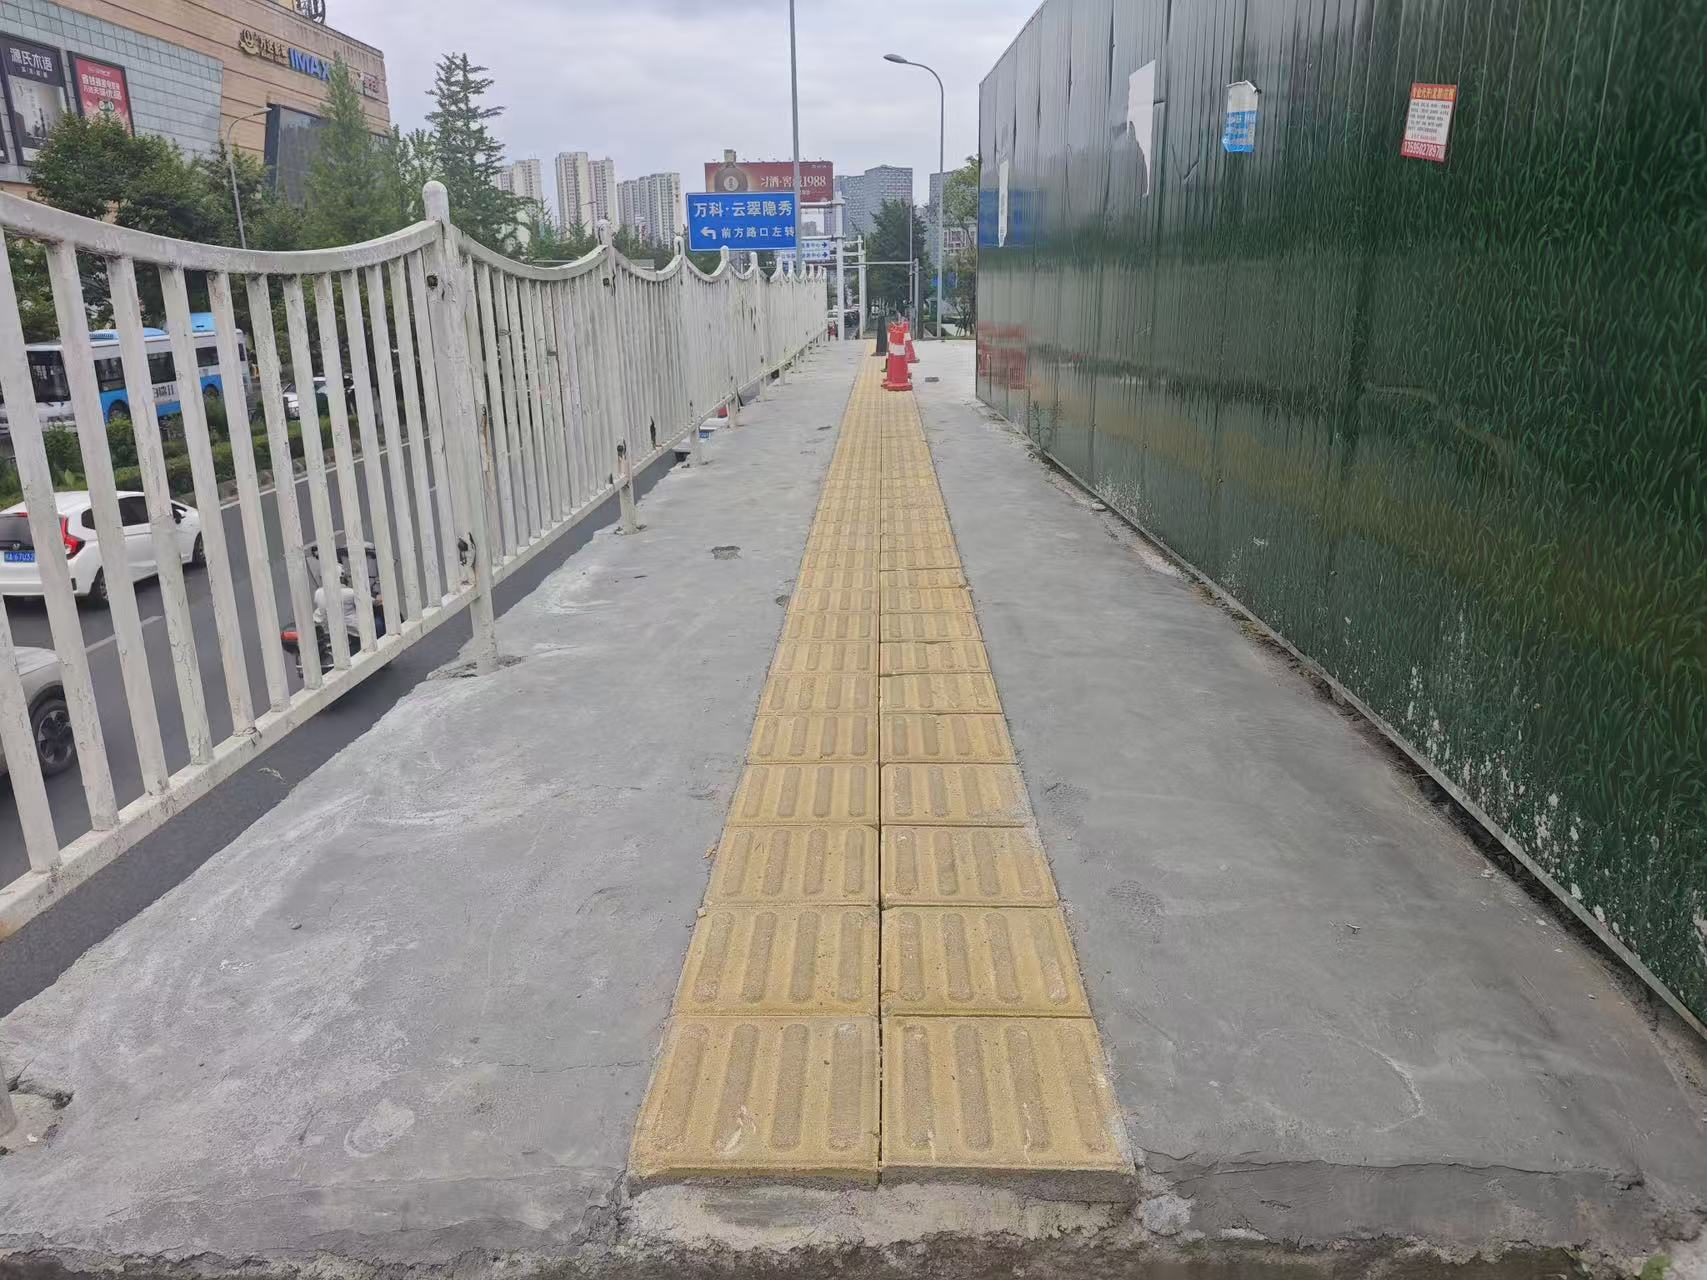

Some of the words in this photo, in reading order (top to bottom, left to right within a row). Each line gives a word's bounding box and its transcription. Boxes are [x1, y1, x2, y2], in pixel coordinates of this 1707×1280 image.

[288, 47, 331, 81] IMAX
[760, 175, 827, 188] 习酒·窖1988
[694, 200, 793, 217] 万科·云翠隐秀
[721, 226, 795, 239] 前方路口左转
